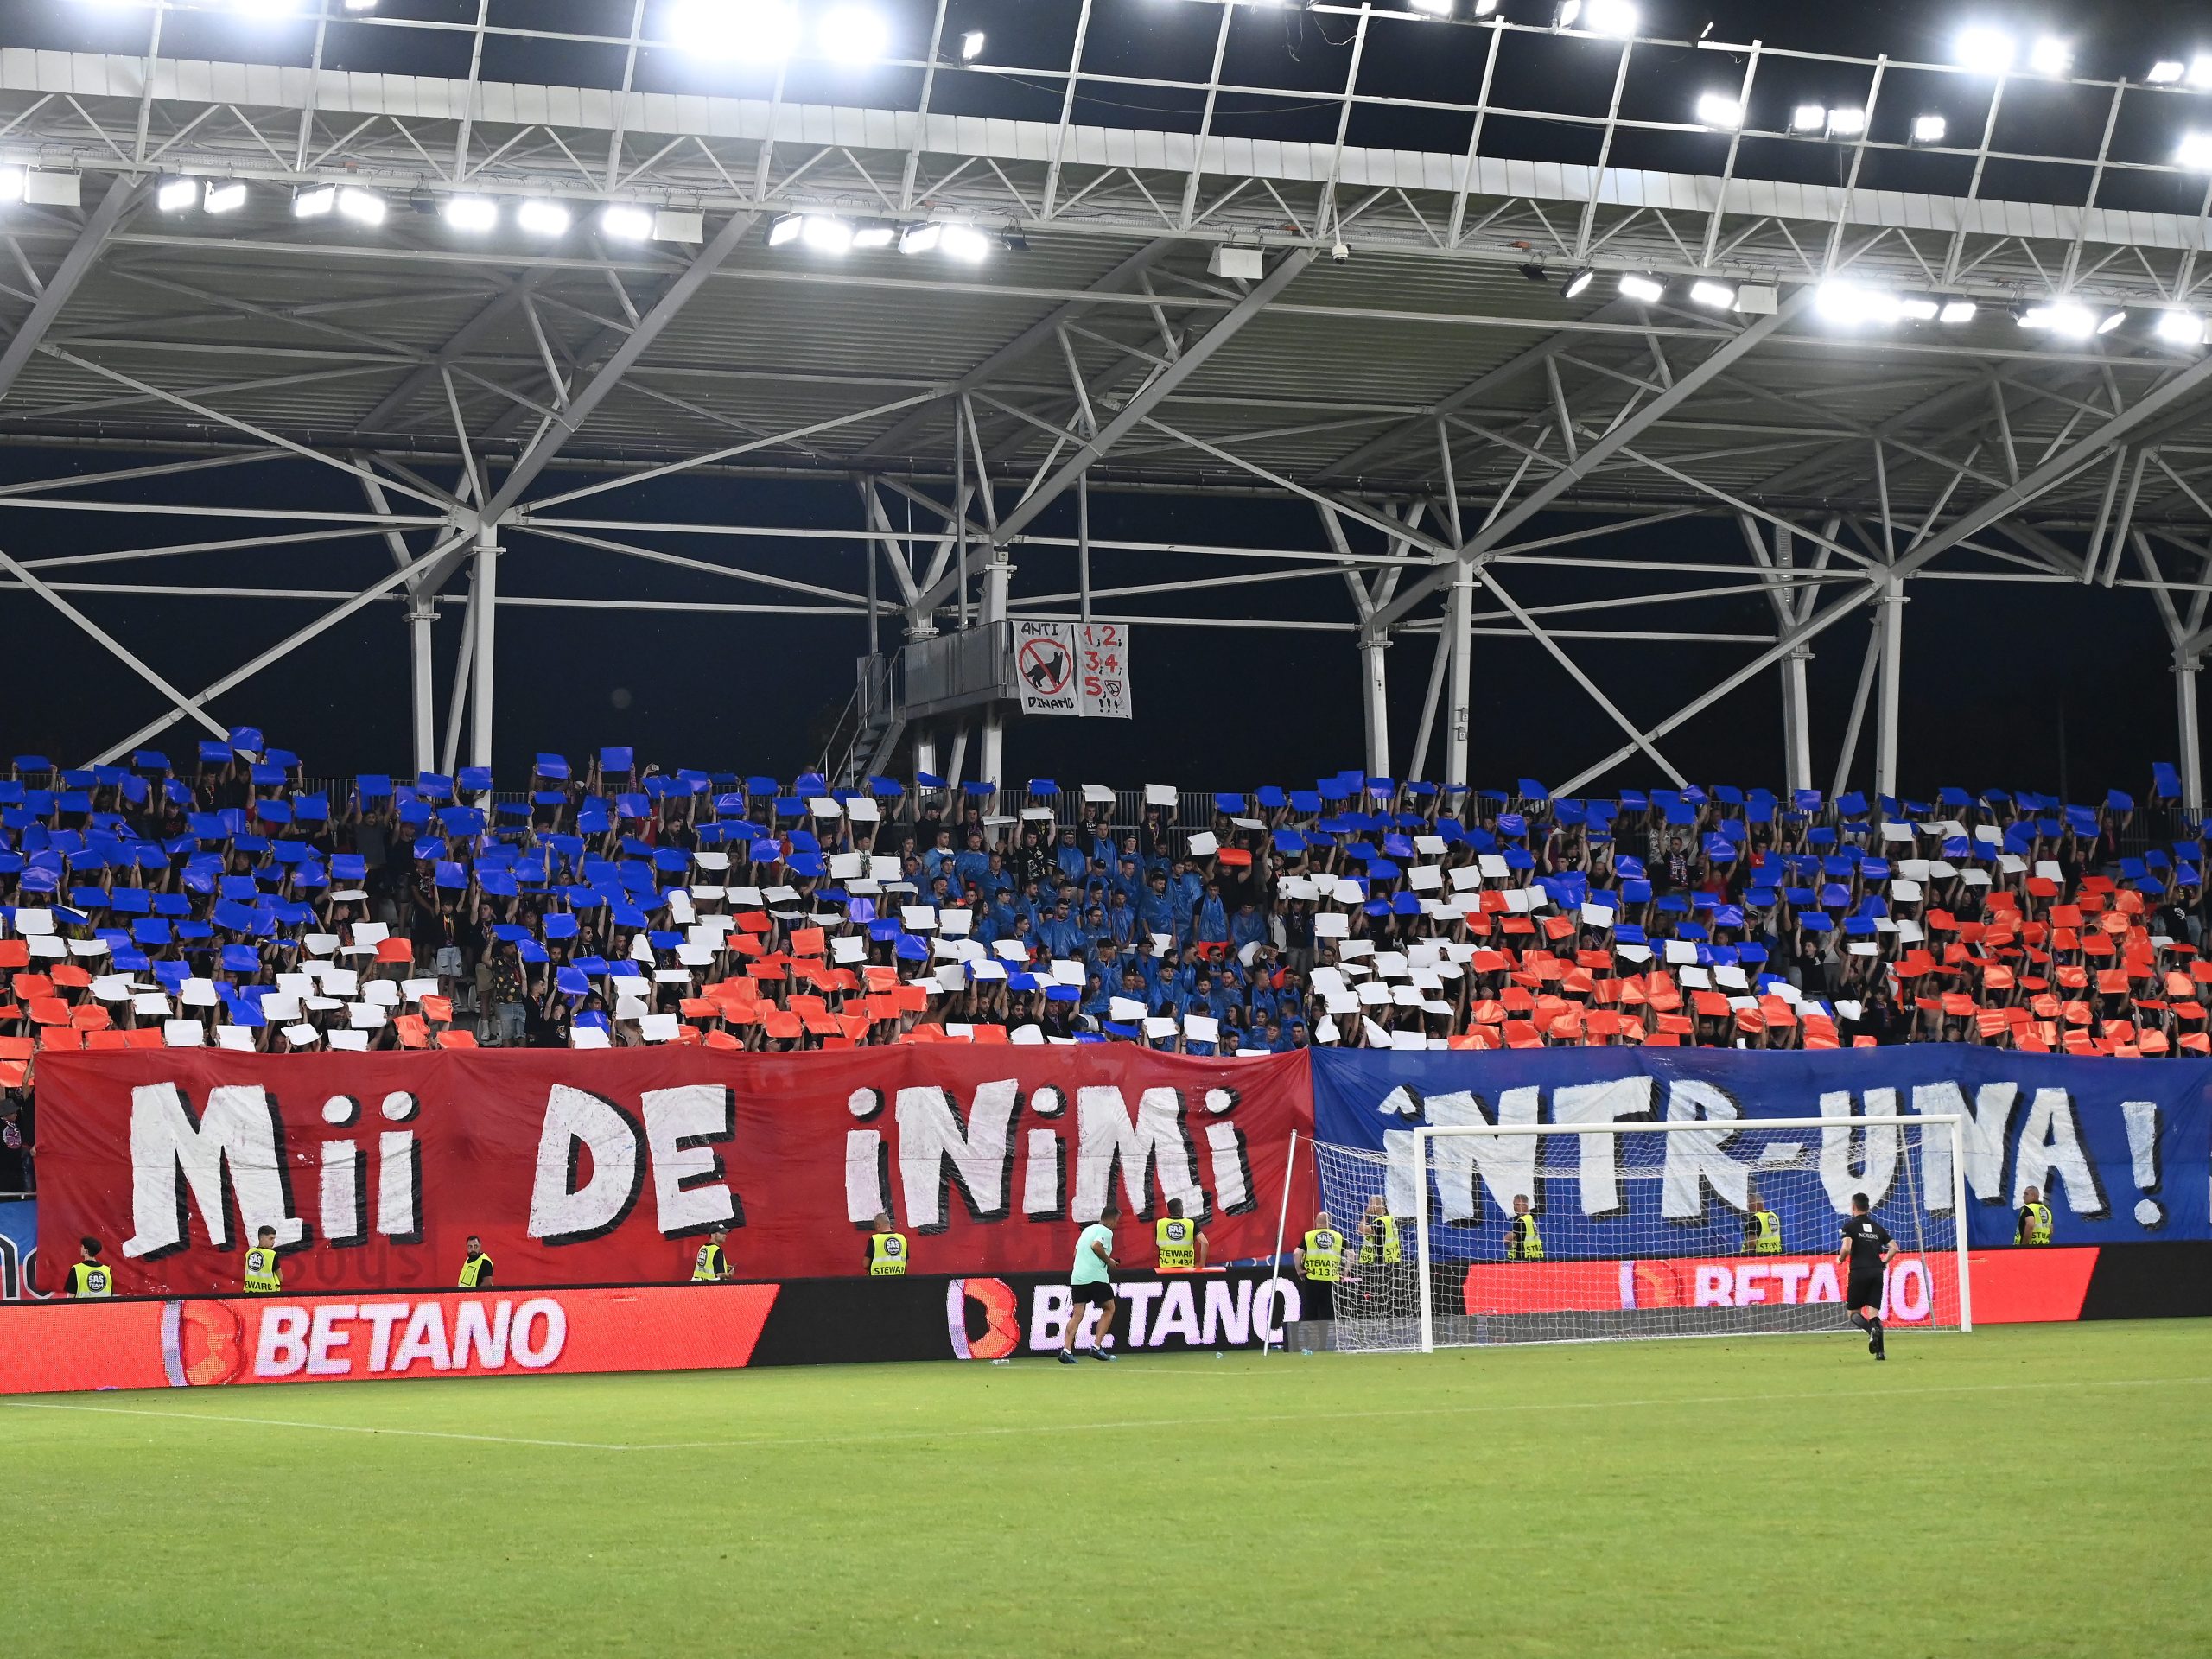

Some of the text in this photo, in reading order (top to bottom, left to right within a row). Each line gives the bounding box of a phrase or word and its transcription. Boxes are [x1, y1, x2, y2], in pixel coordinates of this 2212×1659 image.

[1020, 622, 1059, 636] ANTI
[1028, 696, 1075, 709] DINAMO
[527, 1084, 746, 1246] DE
[249, 1255, 262, 1263] SAS
[89, 1274, 104, 1283] SAS
[253, 1298, 567, 1377] BETANO
